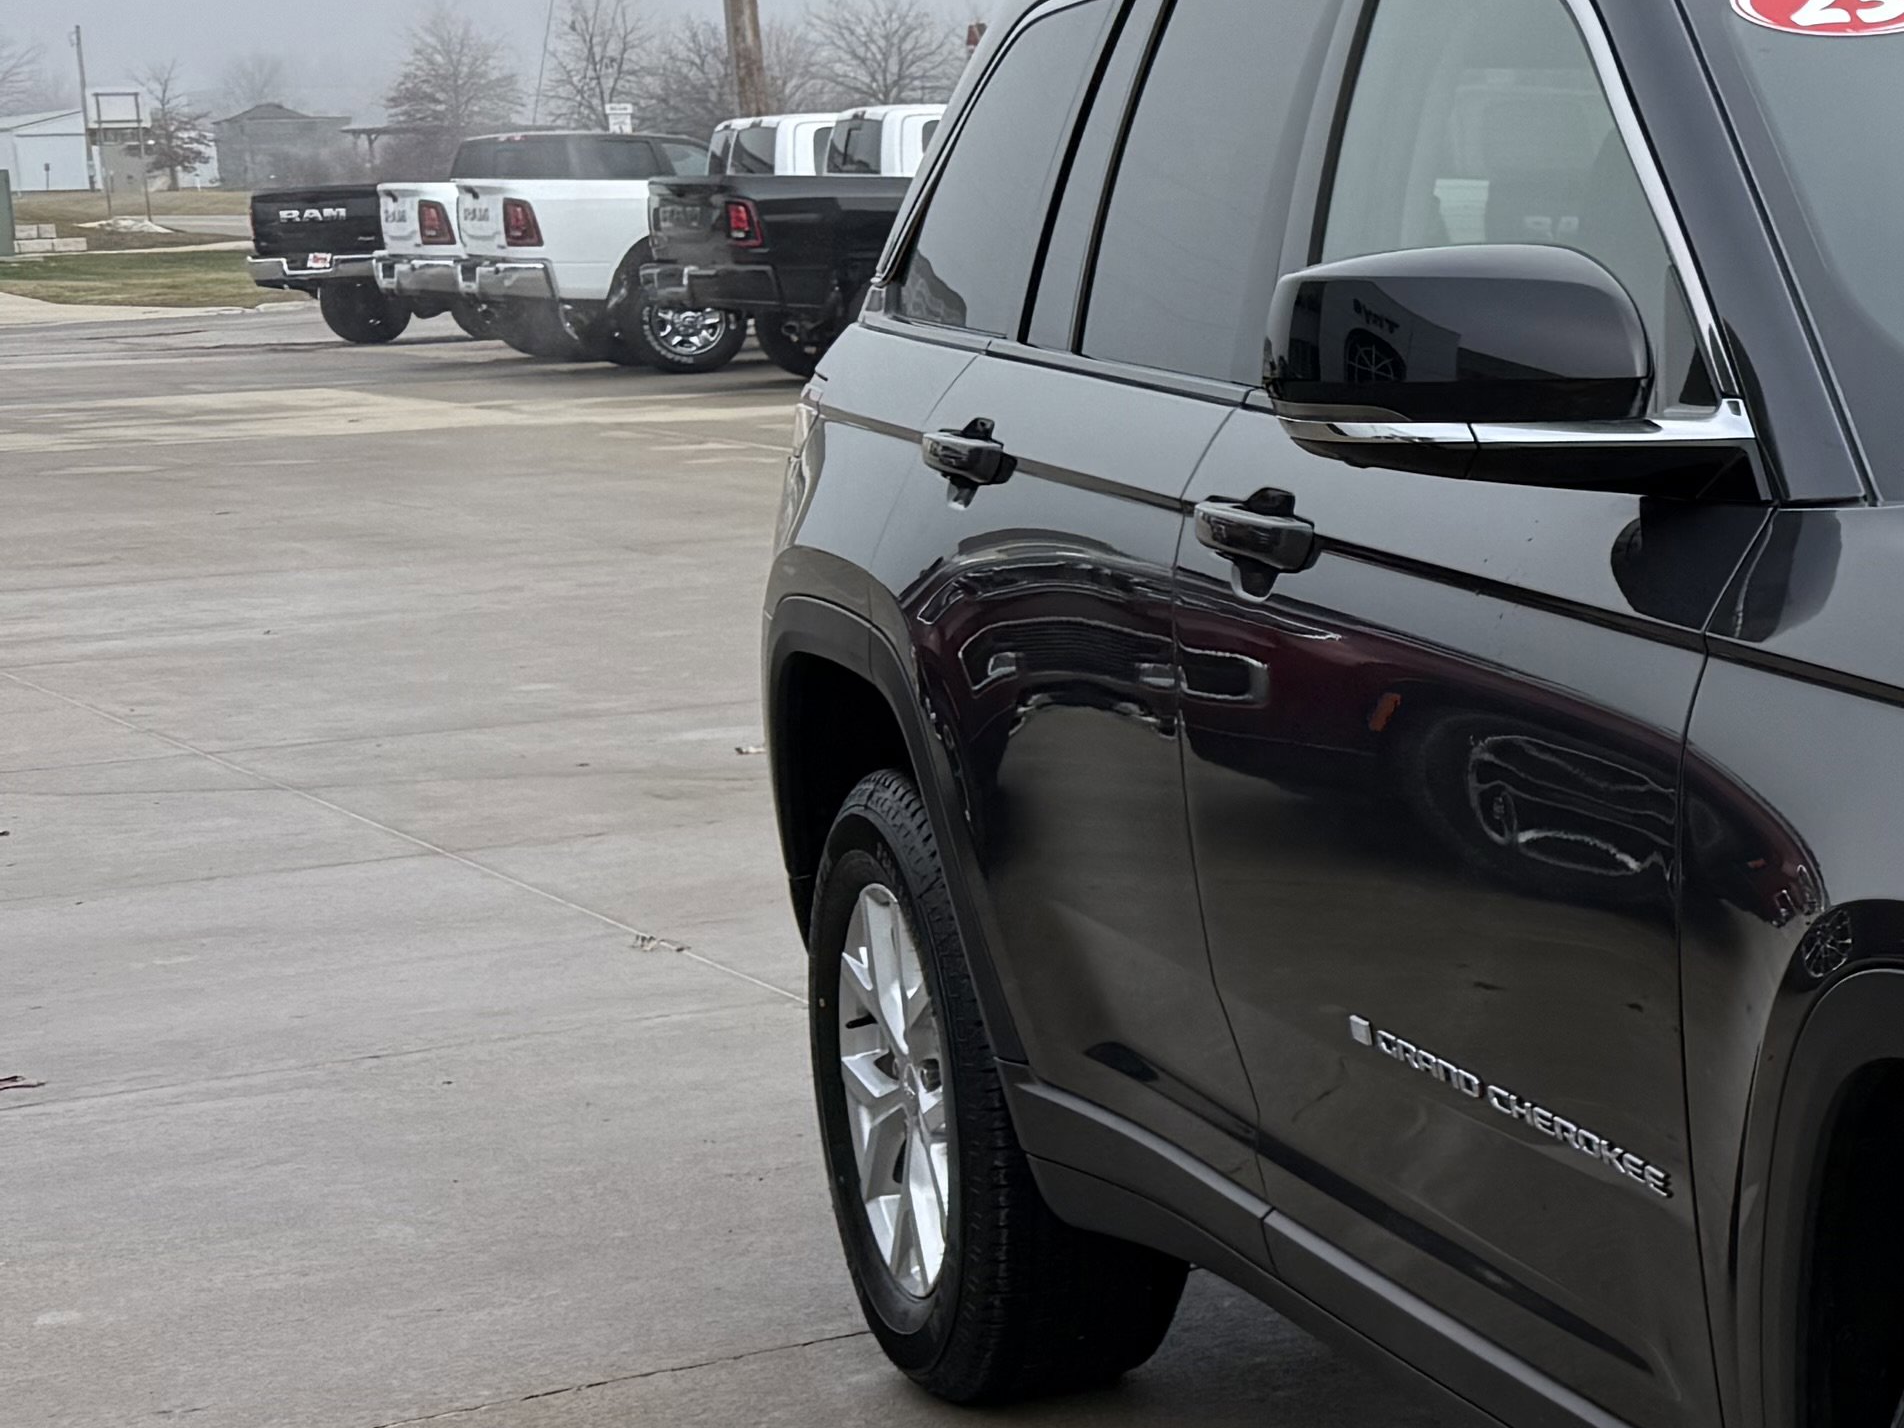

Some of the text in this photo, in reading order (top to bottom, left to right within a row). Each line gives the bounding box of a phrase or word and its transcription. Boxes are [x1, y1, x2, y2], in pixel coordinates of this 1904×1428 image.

[279, 207, 347, 223] RAM
[1376, 1029, 1674, 1199] GRAND CHEROKEE
